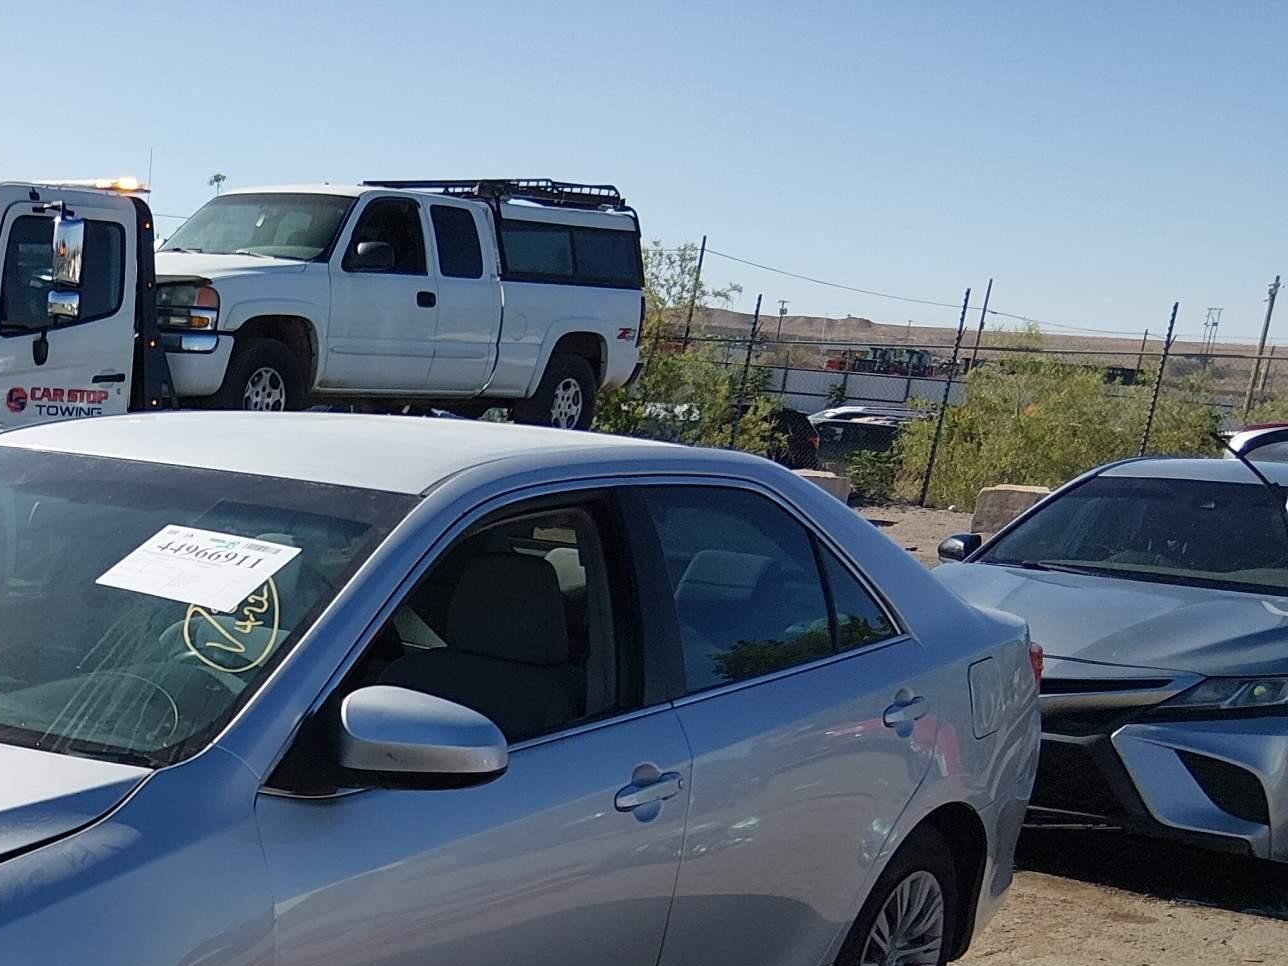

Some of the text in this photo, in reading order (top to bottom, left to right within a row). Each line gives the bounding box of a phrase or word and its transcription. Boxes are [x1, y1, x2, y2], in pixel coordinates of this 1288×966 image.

[30, 387, 109, 404] CAR STOP
[35, 404, 102, 417] TOWING
[157, 541, 263, 569] 44966911
